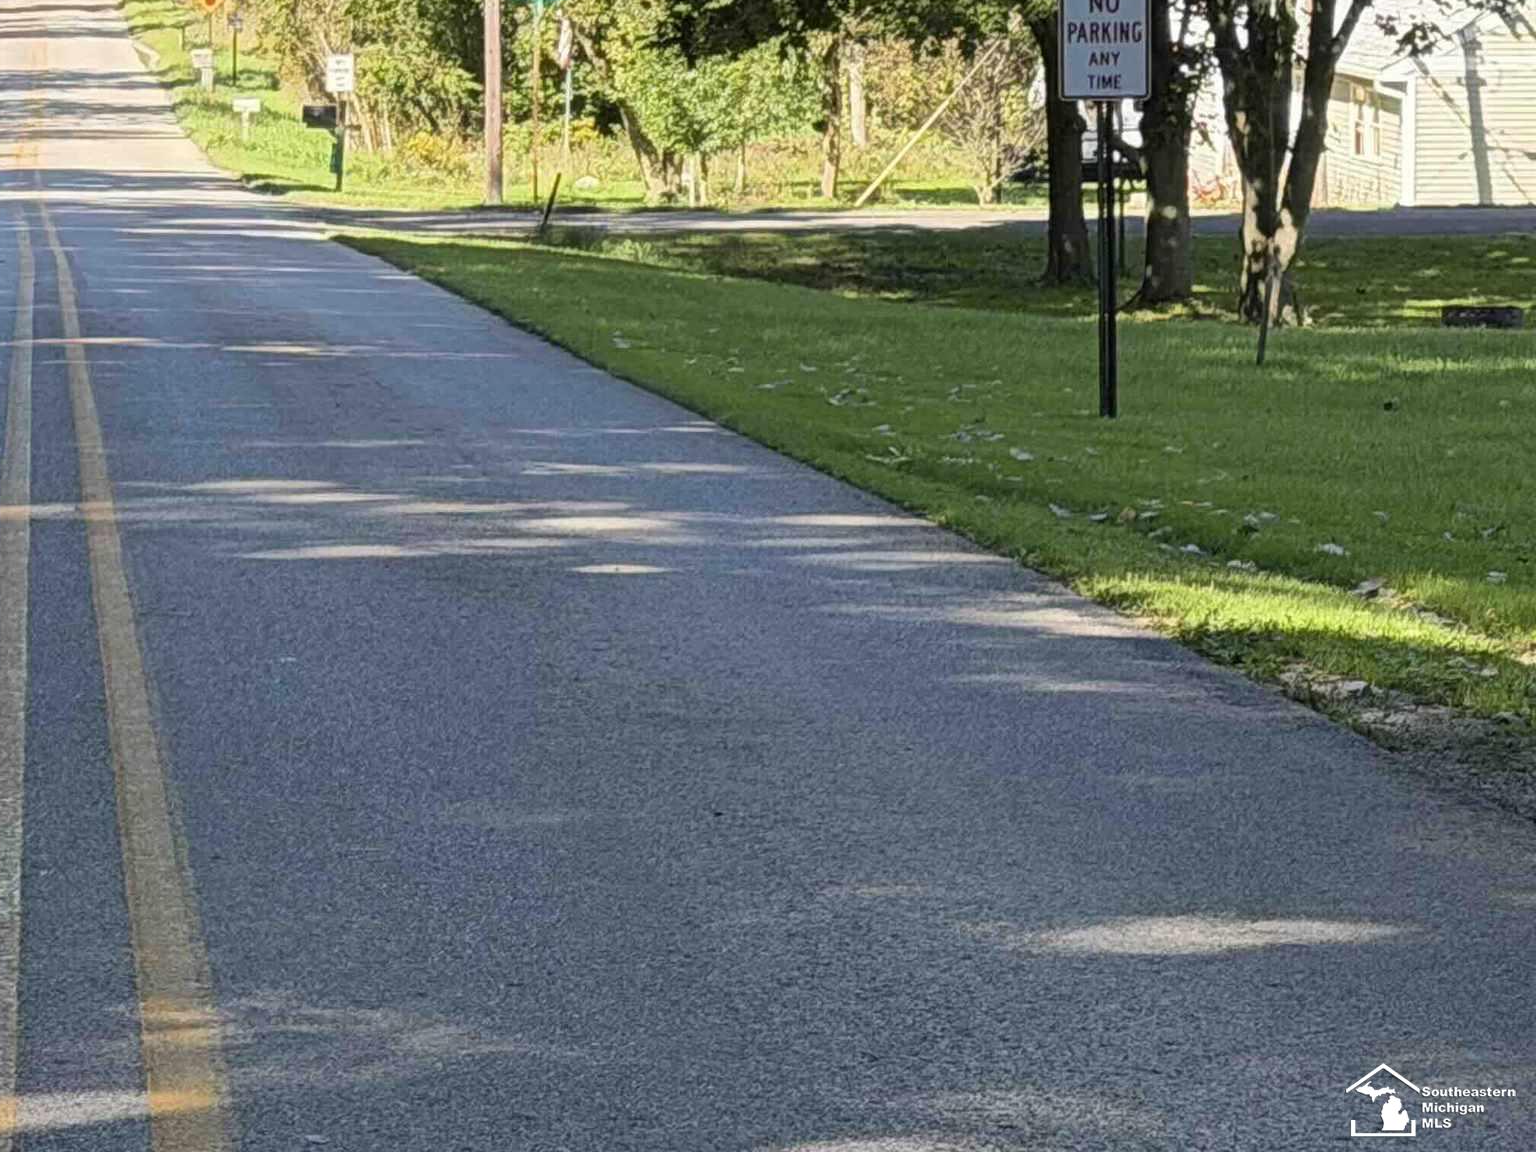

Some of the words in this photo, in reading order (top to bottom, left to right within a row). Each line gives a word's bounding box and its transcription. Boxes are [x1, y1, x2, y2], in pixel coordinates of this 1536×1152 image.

[1067, 22, 1142, 44] PARKING
[1088, 51, 1120, 67] ANY
[1087, 74, 1122, 90] TIME
